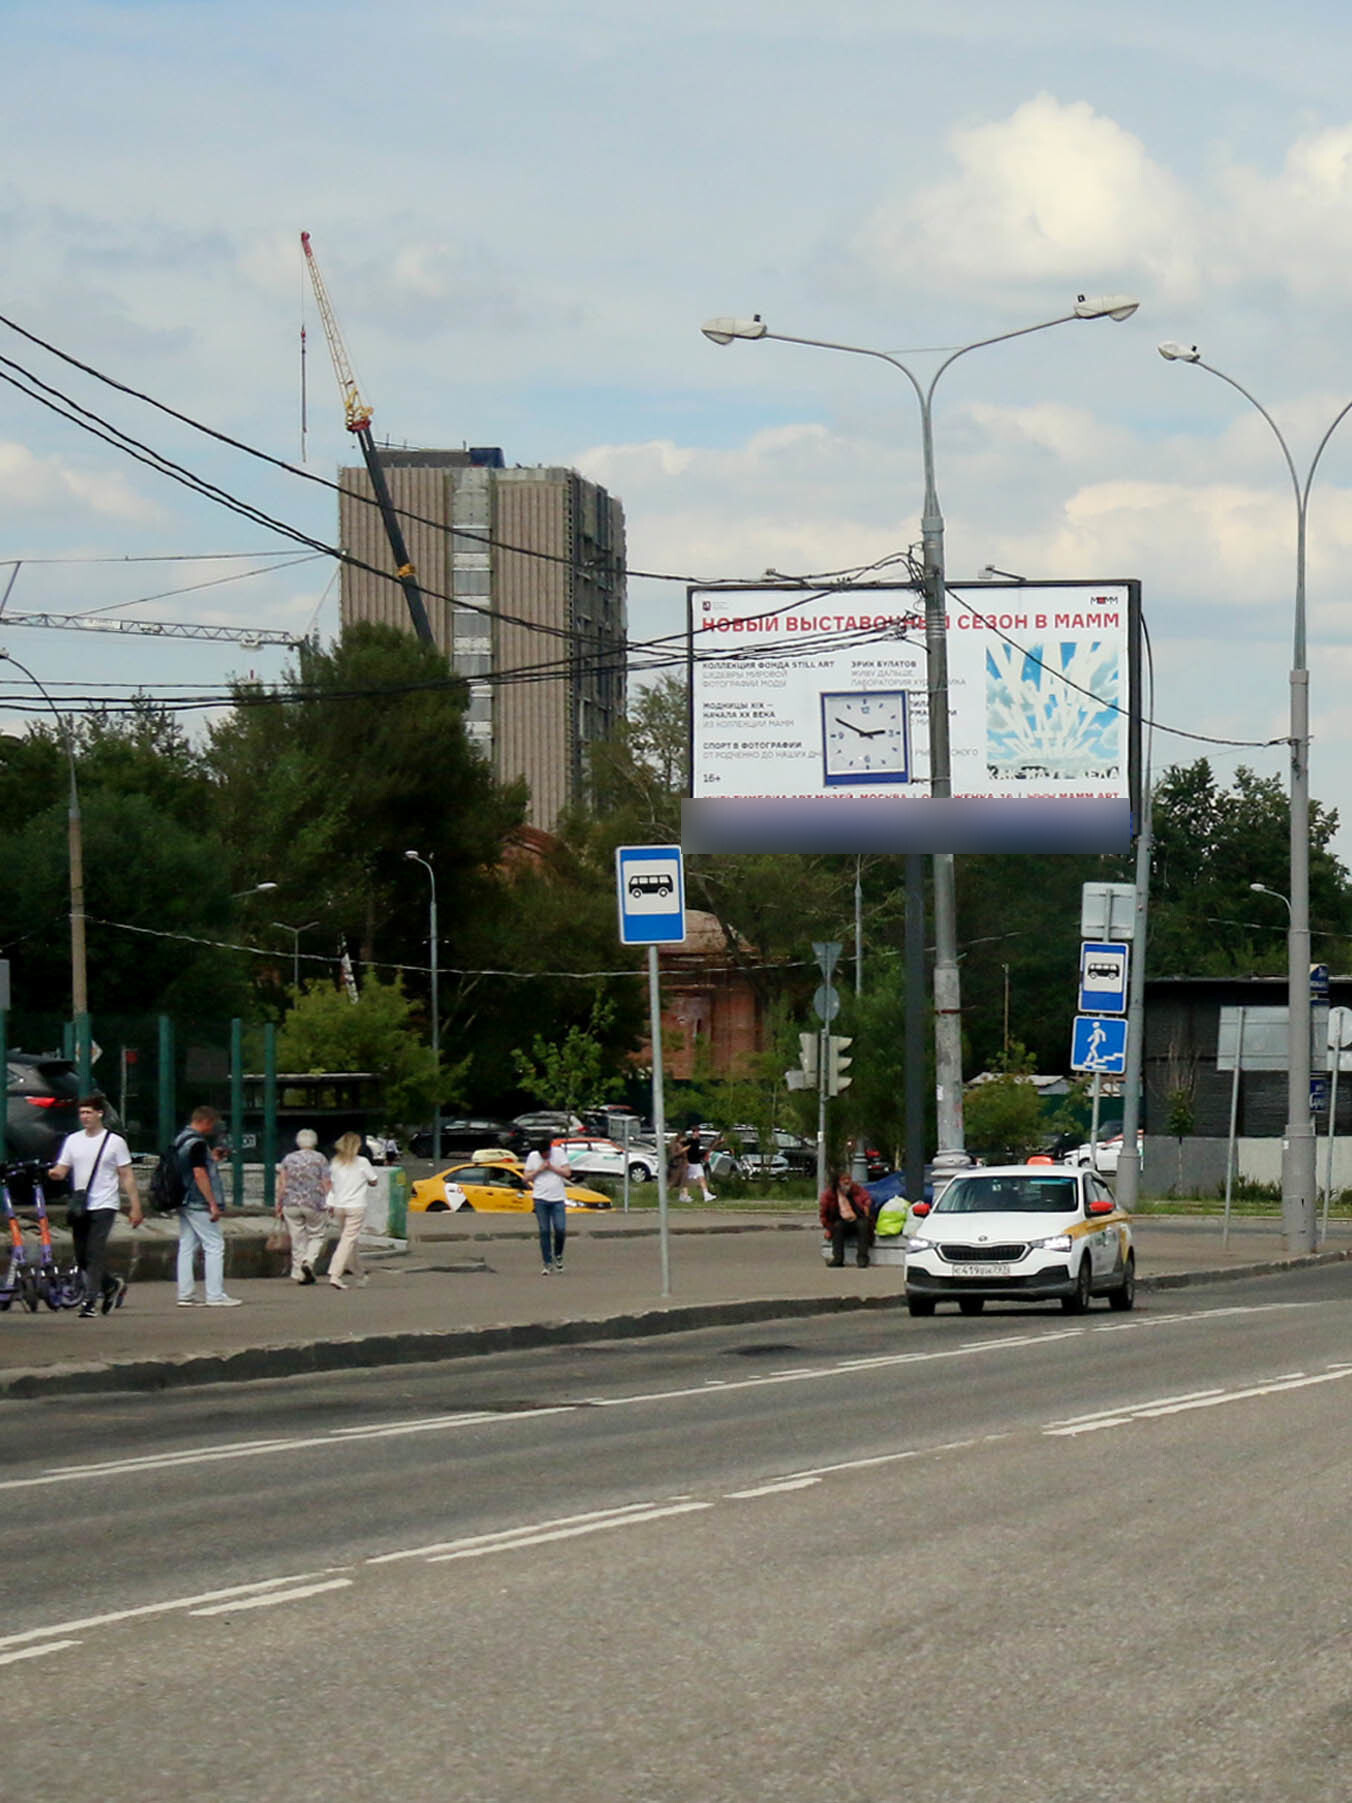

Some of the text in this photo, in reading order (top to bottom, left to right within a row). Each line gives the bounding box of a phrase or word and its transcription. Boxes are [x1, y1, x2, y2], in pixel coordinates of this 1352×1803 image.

[702, 616, 779, 632] НОВЫЙ
[957, 614, 1028, 629] СЕЗОН
[1035, 614, 1047, 628] В
[1054, 613, 1119, 628] МАММ
[702, 661, 755, 669] КОЛЛЕКЦИЯ
[758, 661, 789, 669] ФОНДА
[819, 660, 835, 668] ART
[877, 660, 916, 668] БУЛАТОВ
[703, 711, 737, 719] НАЧАЛА
[752, 710, 776, 718] ВЕКА
[741, 741, 802, 749] ФОТОГРАФИИ
